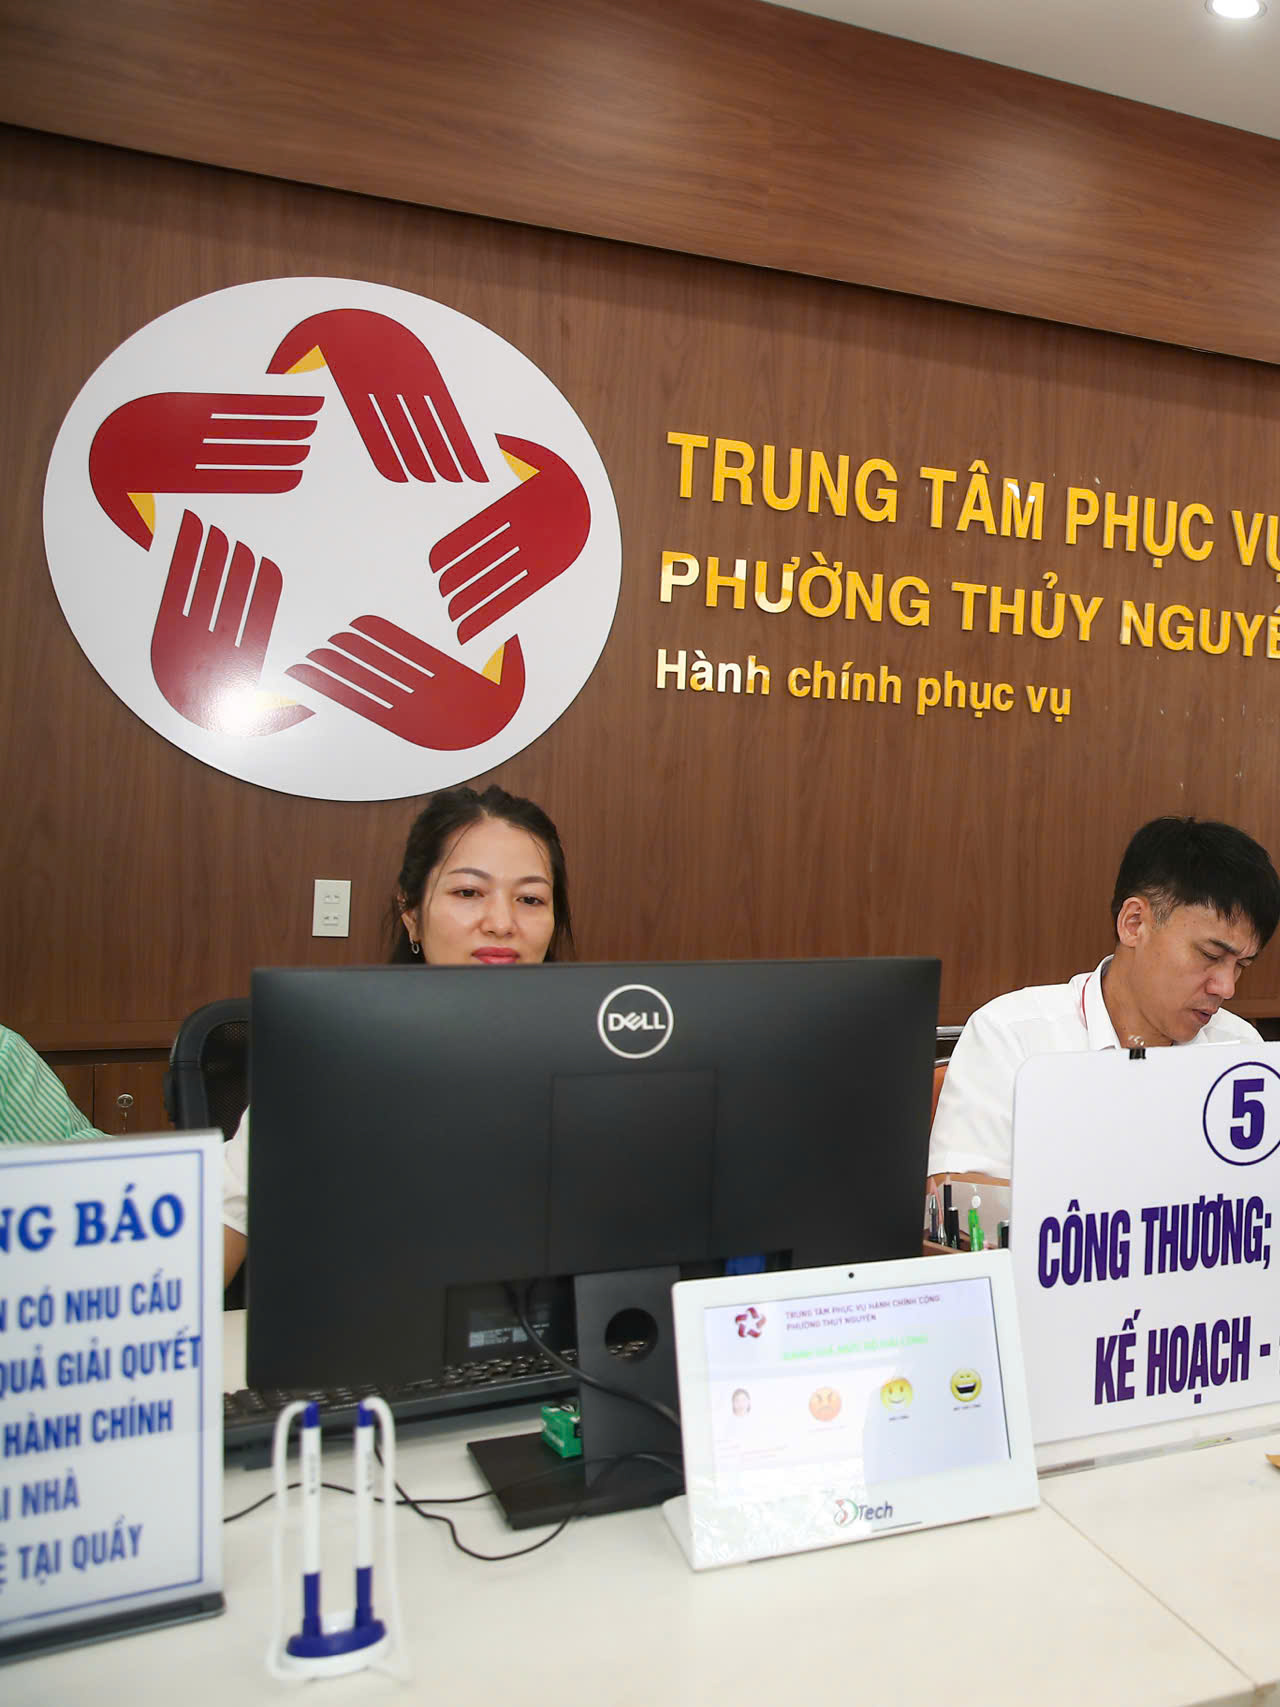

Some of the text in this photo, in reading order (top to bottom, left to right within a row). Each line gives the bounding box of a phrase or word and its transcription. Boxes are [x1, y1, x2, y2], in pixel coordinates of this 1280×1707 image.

[667, 431, 898, 522] TRUNG
[919, 459, 1045, 540] TÂM
[1066, 486, 1214, 569] PHỤC
[659, 550, 931, 627] PHƯỜNG
[951, 571, 1104, 642] THỦY
[655, 648, 1072, 723] Hành chính phục vụ
[607, 1011, 667, 1032] DELL
[1229, 1078, 1265, 1150] 5
[74, 1182, 185, 1247] BÁO
[1038, 1199, 1131, 1289] CÔNG
[1141, 1193, 1273, 1276] THƯƠNG;
[18, 1286, 55, 1330] CÓ
[65, 1286, 120, 1324] NHU
[57, 1336, 112, 1388] GIẢI
[121, 1325, 202, 1381] QUYẾT
[1094, 1309, 1141, 1405] KẾ
[1146, 1315, 1252, 1404] HOẠCH
[1259, 1343, 1271, 1357] -
[4, 1396, 174, 1458] HÀNH CHÍNH
[21, 1468, 80, 1518] NHÀ
[18, 1540, 61, 1586] TẠI
